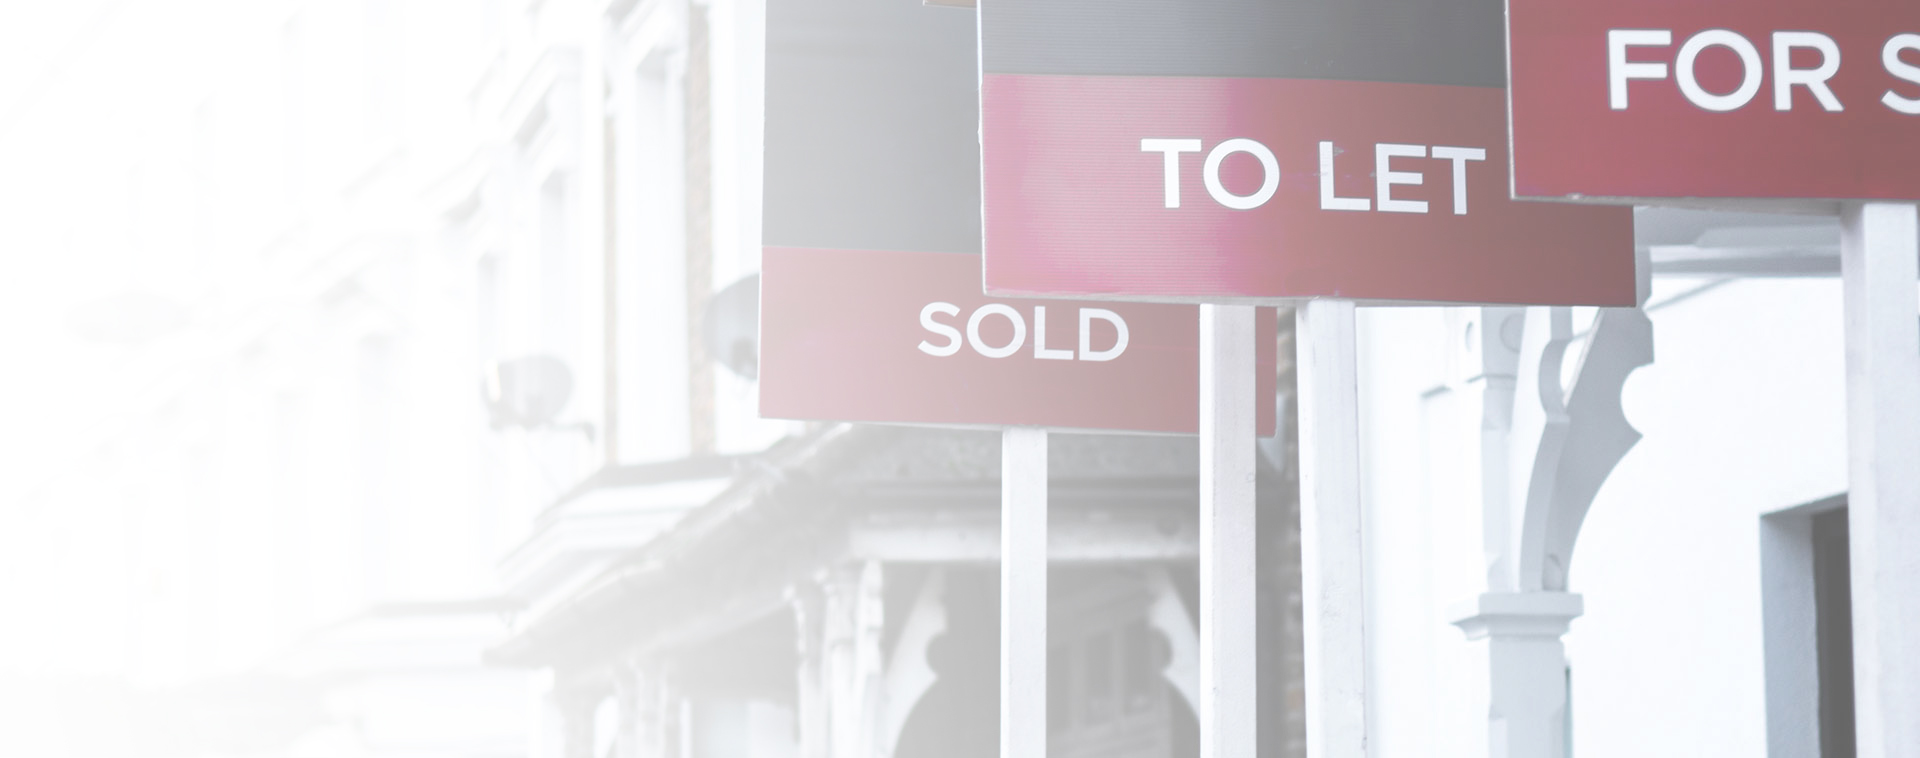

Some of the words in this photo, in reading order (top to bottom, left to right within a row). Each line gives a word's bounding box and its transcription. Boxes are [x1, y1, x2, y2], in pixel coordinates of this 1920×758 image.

[1608, 29, 1844, 111] FOR
[1140, 138, 1280, 209] TO
[1319, 141, 1486, 214] LET
[917, 302, 1129, 361] SOLD
